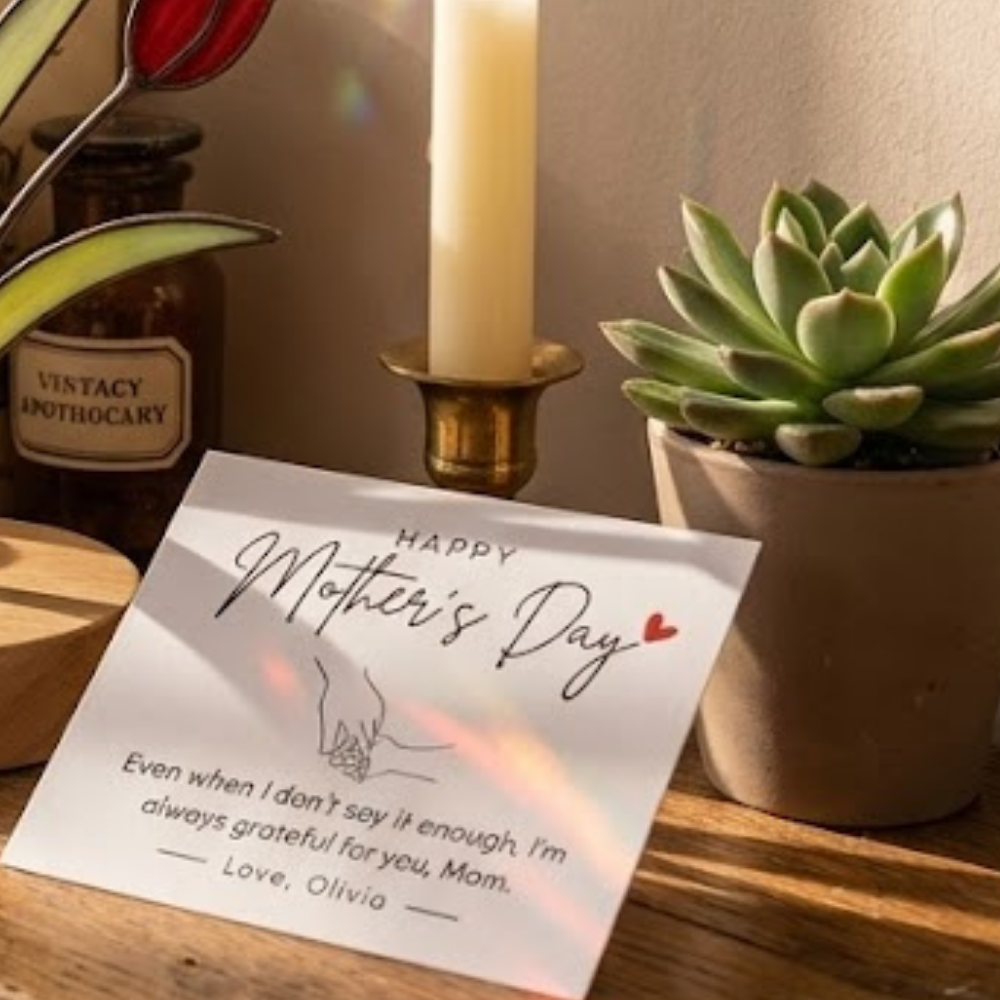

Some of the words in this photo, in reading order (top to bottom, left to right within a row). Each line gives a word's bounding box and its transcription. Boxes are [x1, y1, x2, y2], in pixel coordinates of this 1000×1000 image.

[393, 528, 518, 566] HAPPY
[214, 531, 489, 647] Mother's
[495, 580, 641, 702] Day
[121, 750, 183, 783] Even
[187, 767, 256, 799] when
[260, 780, 274, 802] I
[272, 784, 341, 817] don't
[391, 807, 414, 832] it
[526, 835, 569, 866] I'm
[222, 855, 292, 892] Love,
[337, 835, 378, 863] for
[438, 858, 512, 895] Mom.
